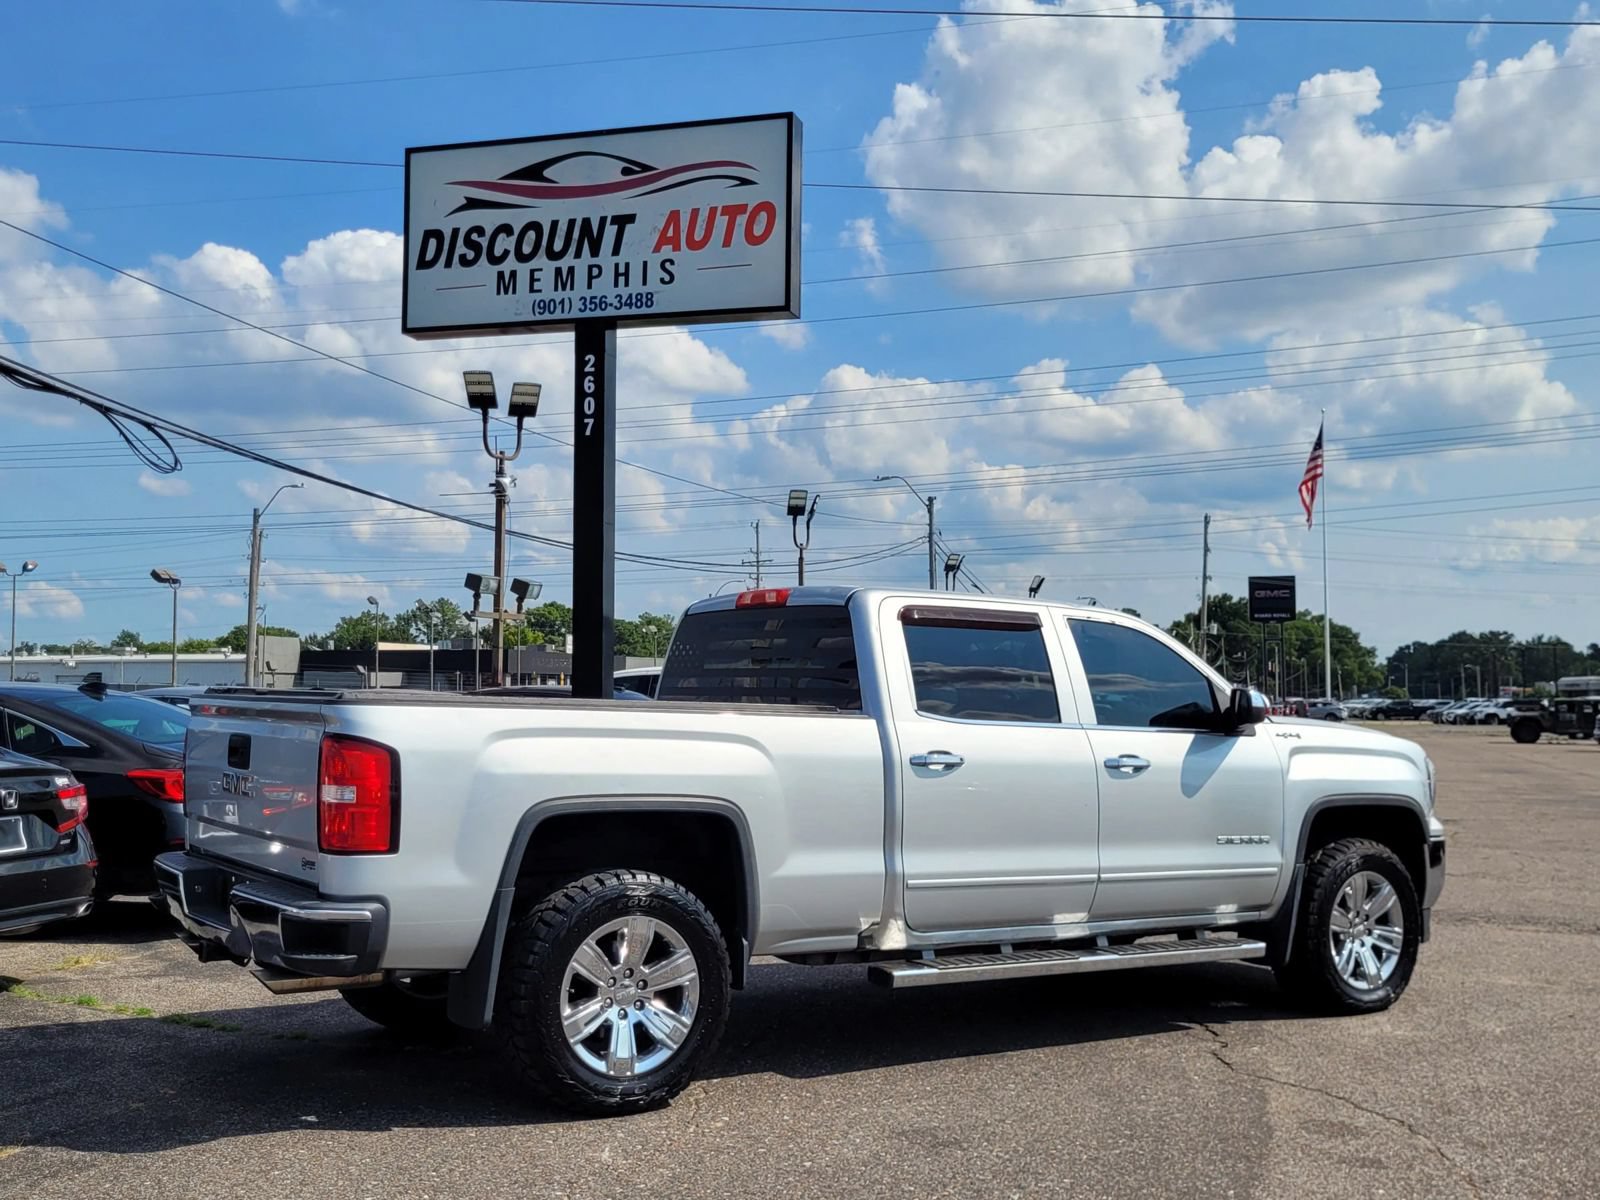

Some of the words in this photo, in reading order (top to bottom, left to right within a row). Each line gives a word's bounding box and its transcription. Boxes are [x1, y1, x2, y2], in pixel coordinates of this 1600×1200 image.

[415, 213, 637, 271] DISCOUNT
[651, 200, 777, 254] AUTO
[496, 258, 675, 296] MEMPHIS
[531, 296, 573, 316] (901)
[578, 292, 654, 313] 356-3488
[583, 354, 596, 436] 2607
[1255, 590, 1291, 598] GMC
[223, 771, 255, 798] GMC
[1217, 835, 1271, 845] SIERRA
